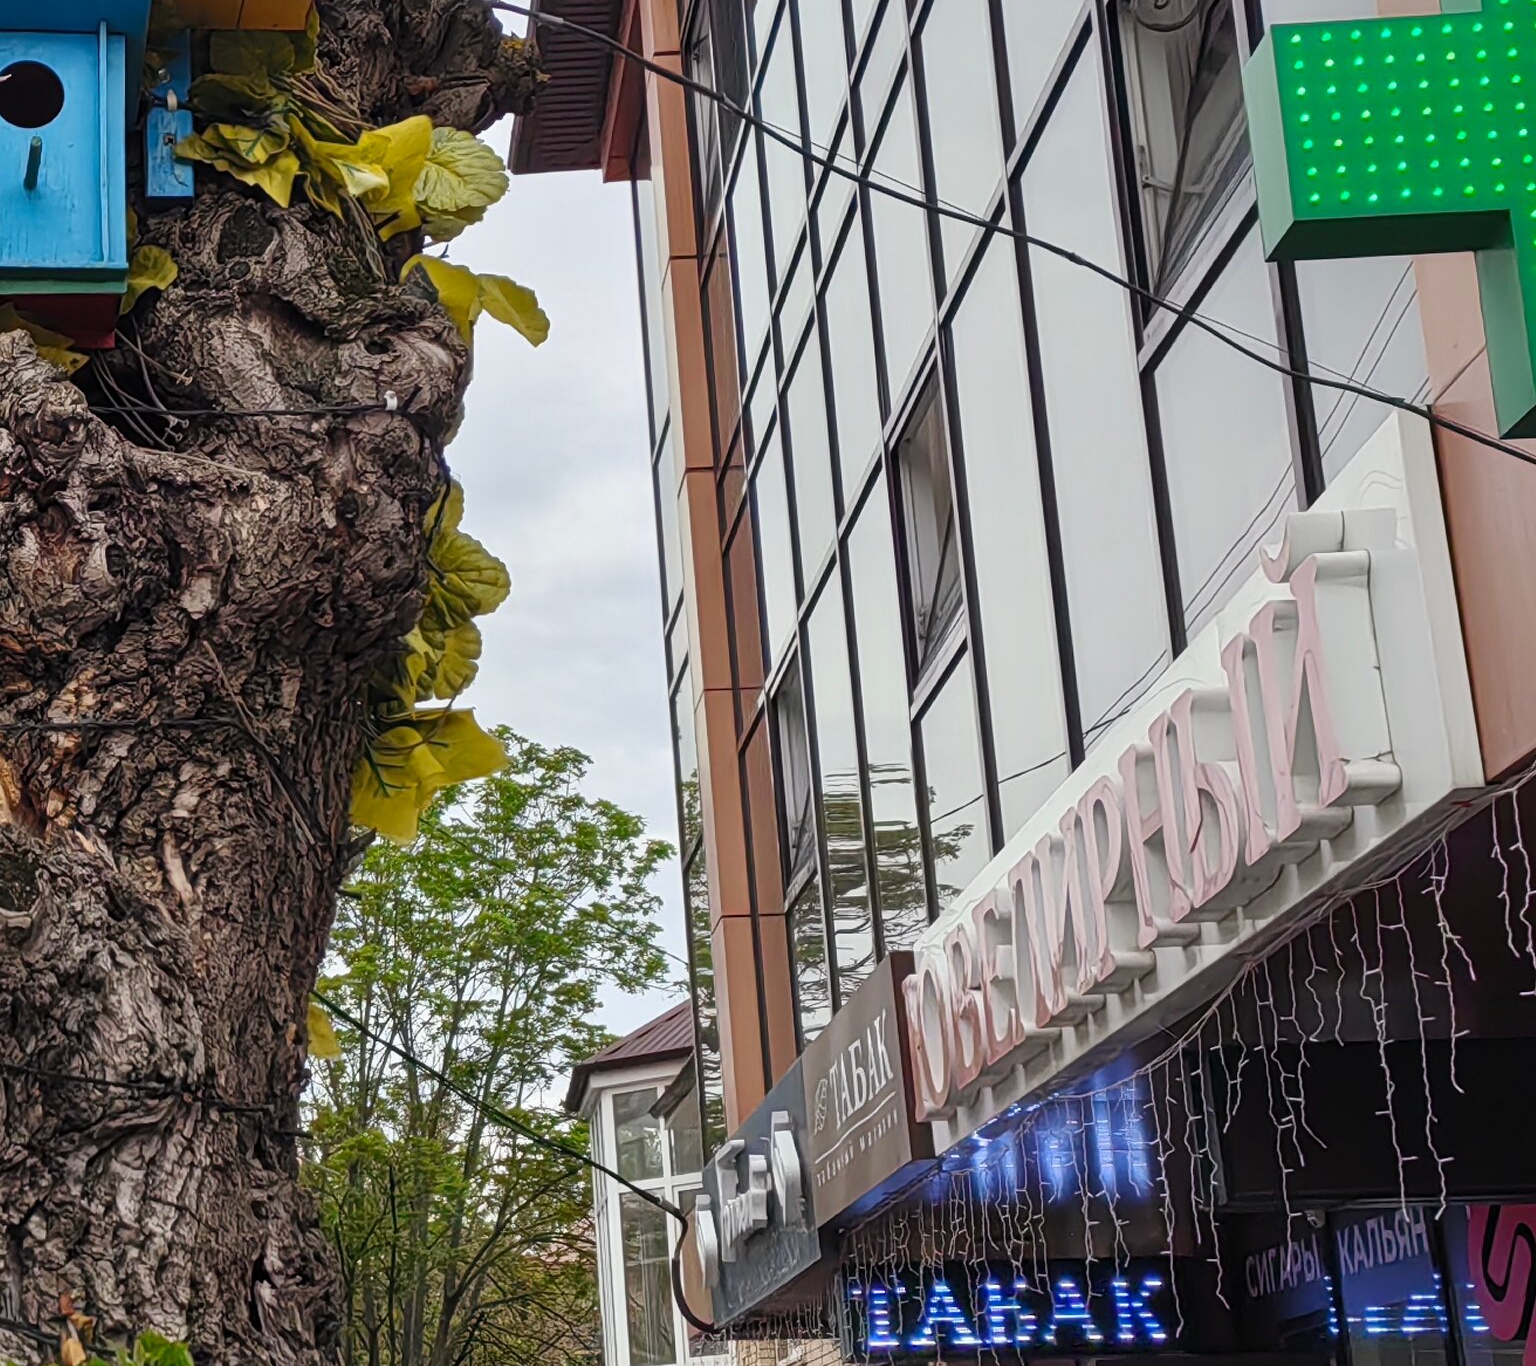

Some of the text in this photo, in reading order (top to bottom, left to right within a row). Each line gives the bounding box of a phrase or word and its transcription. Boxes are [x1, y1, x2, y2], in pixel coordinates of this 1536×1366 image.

[902, 525, 1360, 1122] ЮВЕЛИРНЫЙ
[828, 1008, 894, 1130] ТАБАК
[1245, 1233, 1322, 1297] СИГАРЫ
[1336, 1207, 1429, 1276] КАЛЬЯН
[850, 1280, 1167, 1347] ТАБАК
